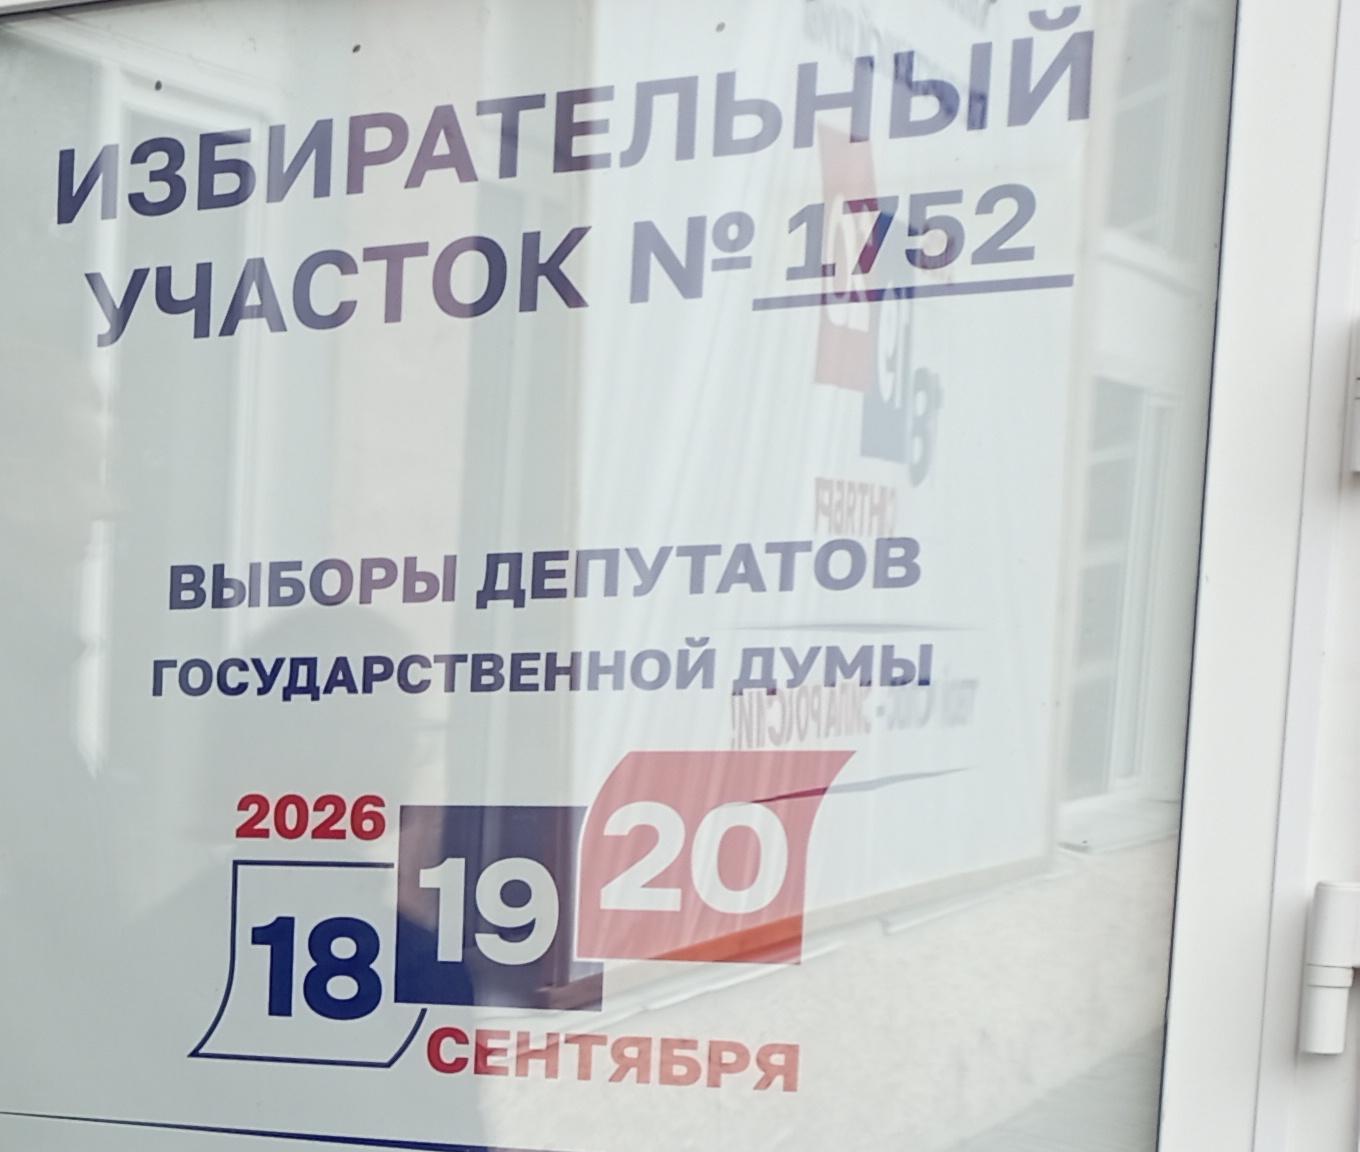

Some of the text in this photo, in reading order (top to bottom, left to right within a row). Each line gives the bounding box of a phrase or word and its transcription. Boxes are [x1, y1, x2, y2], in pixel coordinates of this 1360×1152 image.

[55, 7, 1096, 225] ИЗБИРАТЕЛЬНЫЙ
[85, 226, 591, 347] УЧАСТОК
[630, 210, 756, 306] №
[786, 184, 1038, 282] 1752
[168, 536, 921, 611] ВЫБОРЫ ДЕПУТАТОВ
[151, 637, 933, 699] ГОСУДАРСТВЕННОЙ ДУМЫ
[235, 793, 386, 842] 2026
[600, 800, 790, 916] 20
[418, 856, 559, 966] 19
[250, 916, 383, 1021] 18
[426, 1026, 801, 1094] СЕНТЯБРЯ
